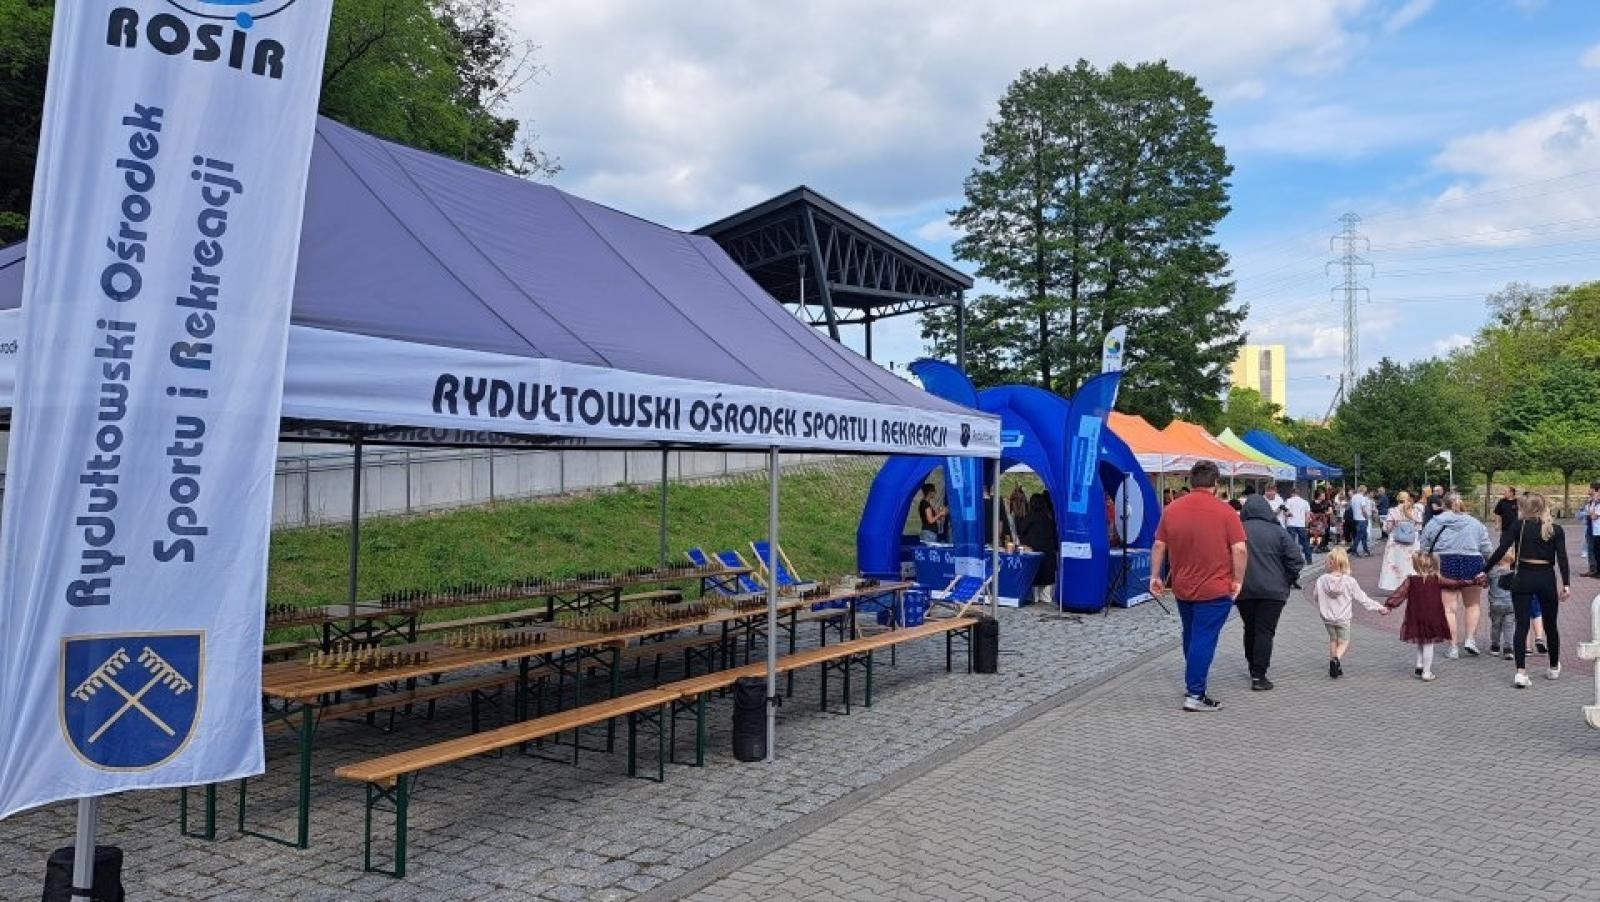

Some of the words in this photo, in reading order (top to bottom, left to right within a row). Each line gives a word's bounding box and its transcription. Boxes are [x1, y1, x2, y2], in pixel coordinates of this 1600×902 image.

[100, 102, 164, 302] Ośrodek
[170, 155, 244, 371] Rekreacji
[65, 319, 137, 608] Rydułtowski
[166, 386, 210, 399] i
[432, 373, 681, 430] RYDUŁTOWSKI
[689, 392, 797, 436] OŚRODEK
[802, 411, 868, 443] SPORTU
[872, 418, 877, 442] I
[881, 419, 948, 448] REKREACJI
[153, 415, 209, 563] Sportu
